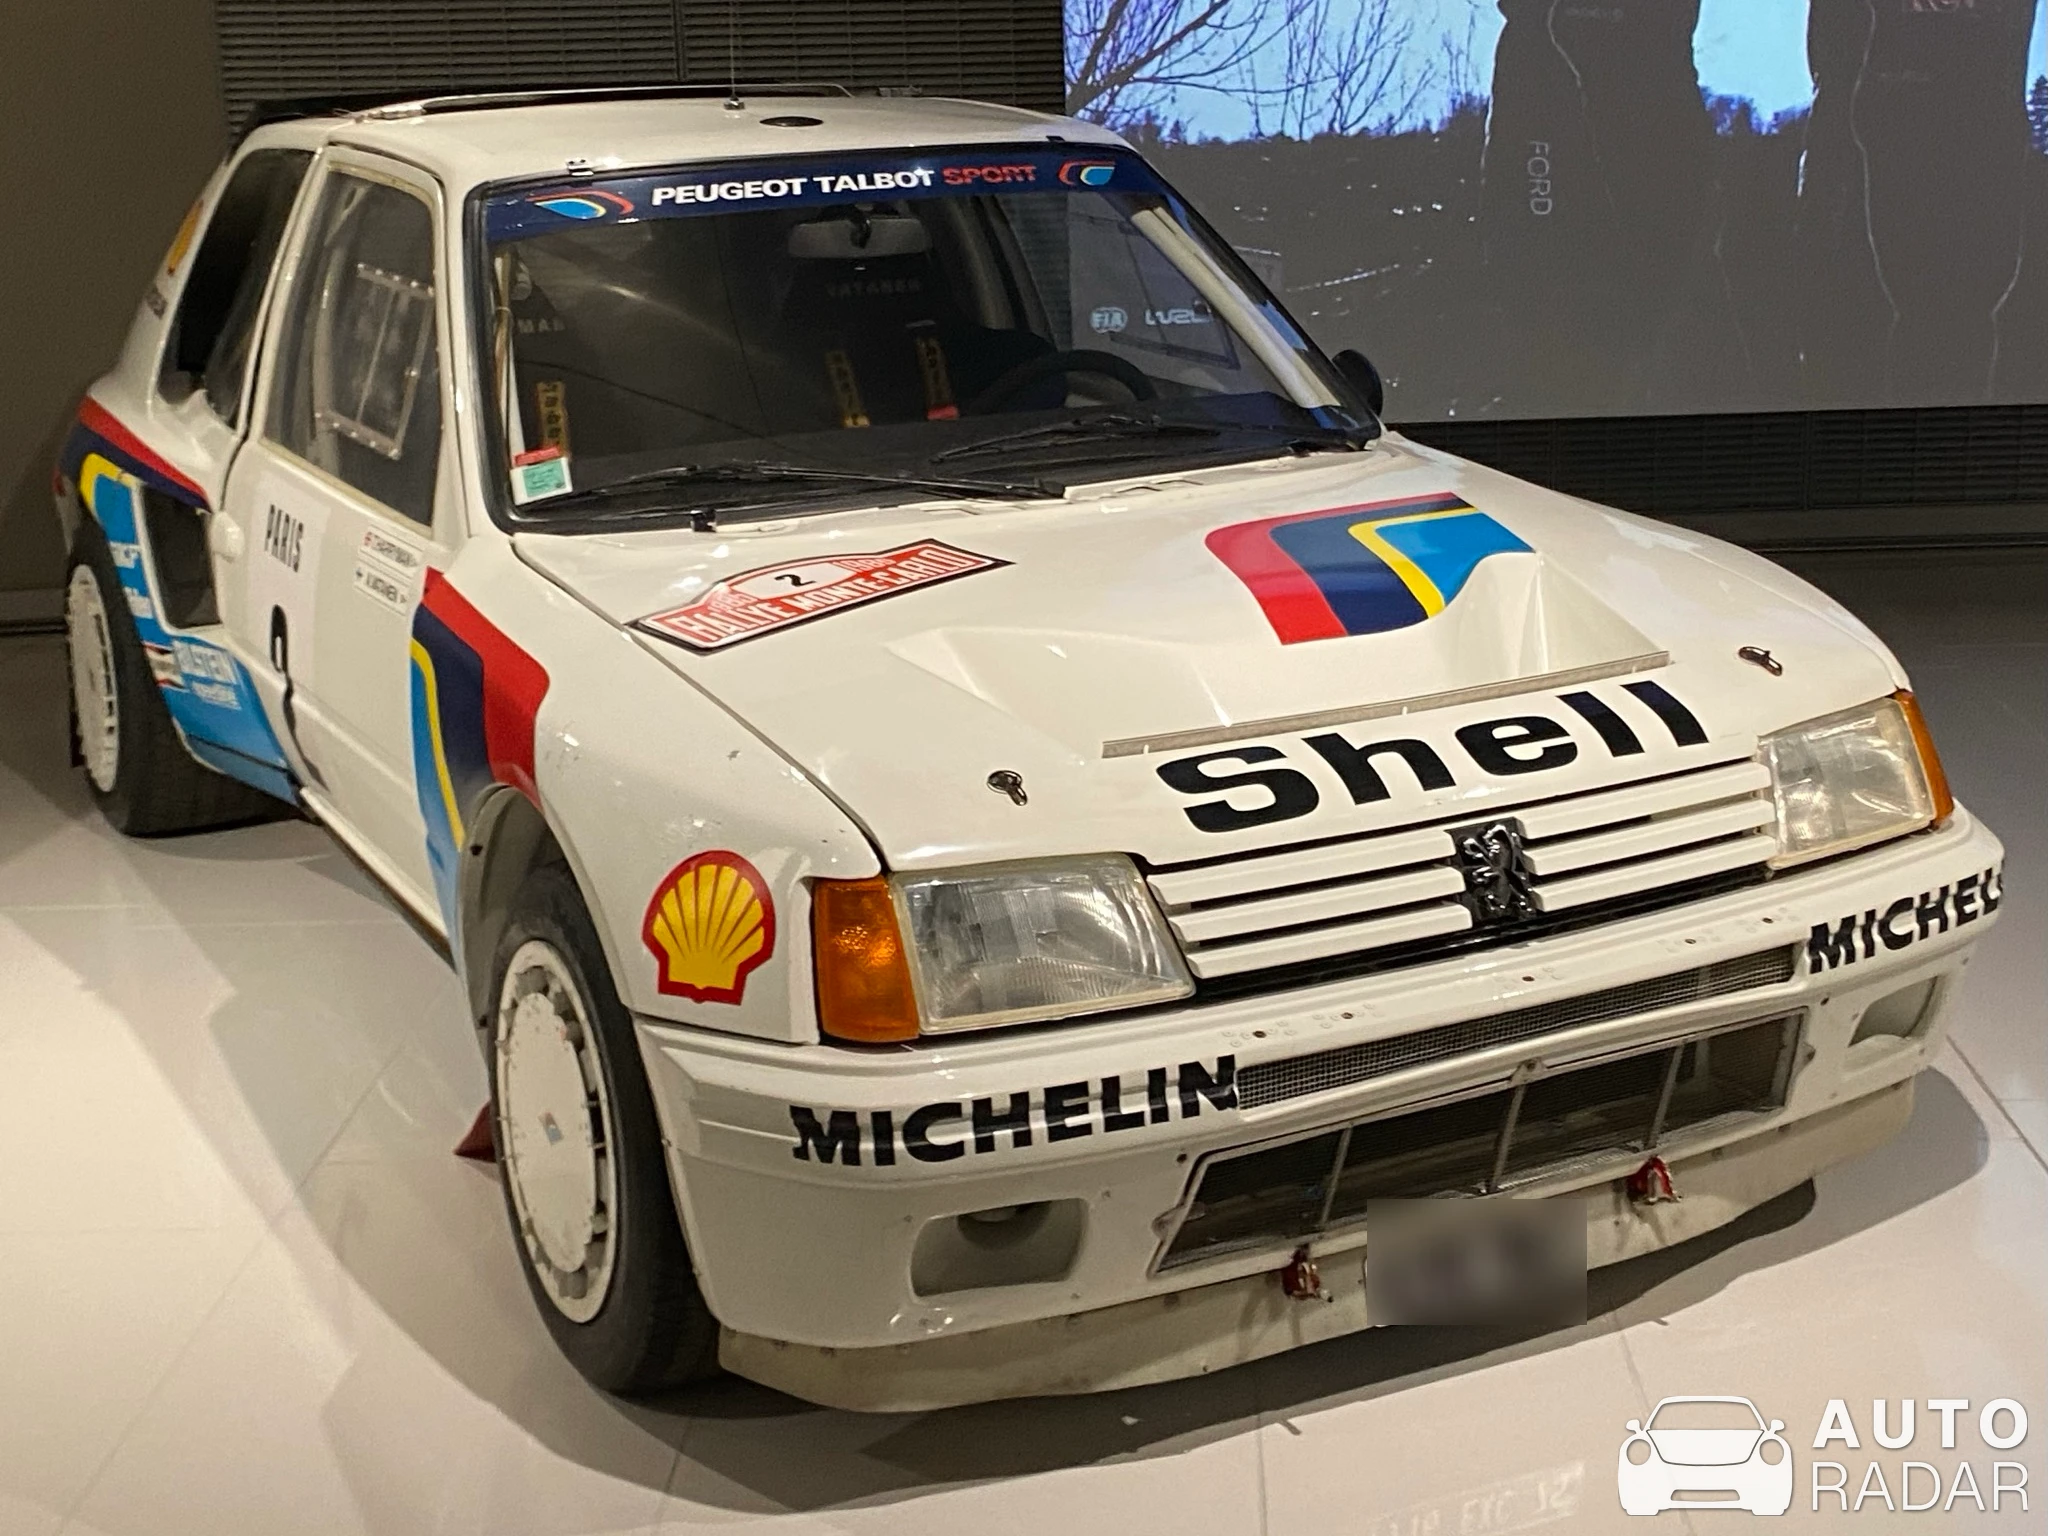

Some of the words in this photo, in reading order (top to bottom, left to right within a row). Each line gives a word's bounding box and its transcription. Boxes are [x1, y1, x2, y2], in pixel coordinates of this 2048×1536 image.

[651, 177, 807, 206] PEUGEOT
[812, 168, 934, 194] TALBOT
[942, 164, 1036, 186] SPORT
[1526, 140, 1553, 217] FORD
[264, 504, 304, 573] PARIS
[774, 573, 817, 588] 2
[664, 598, 800, 641] RALLYE
[1156, 680, 1710, 833] Shell
[789, 1053, 1239, 1167] MICHELIN
